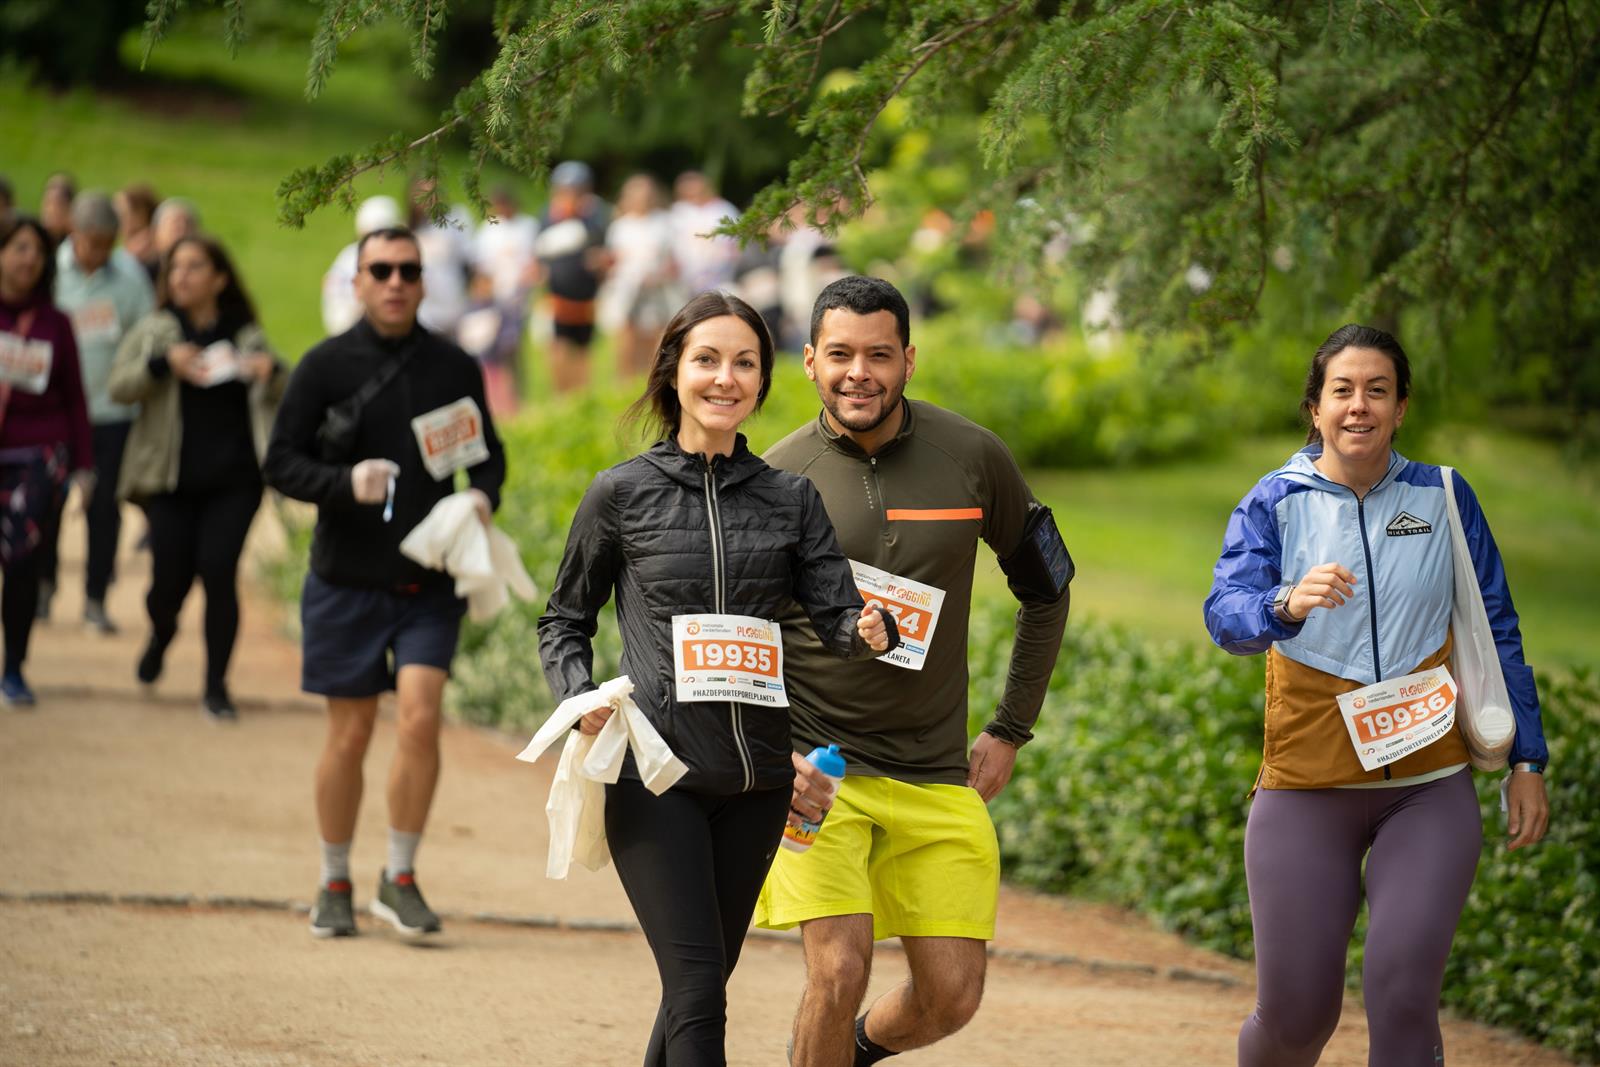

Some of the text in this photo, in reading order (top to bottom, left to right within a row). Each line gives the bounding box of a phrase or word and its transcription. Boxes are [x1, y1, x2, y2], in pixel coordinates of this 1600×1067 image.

[691, 643, 771, 672] 19935
[883, 652, 910, 665] LANETA
[692, 689, 776, 702] #HAZDEPORTEPORELPLANETA
[1361, 692, 1447, 737] 19936
